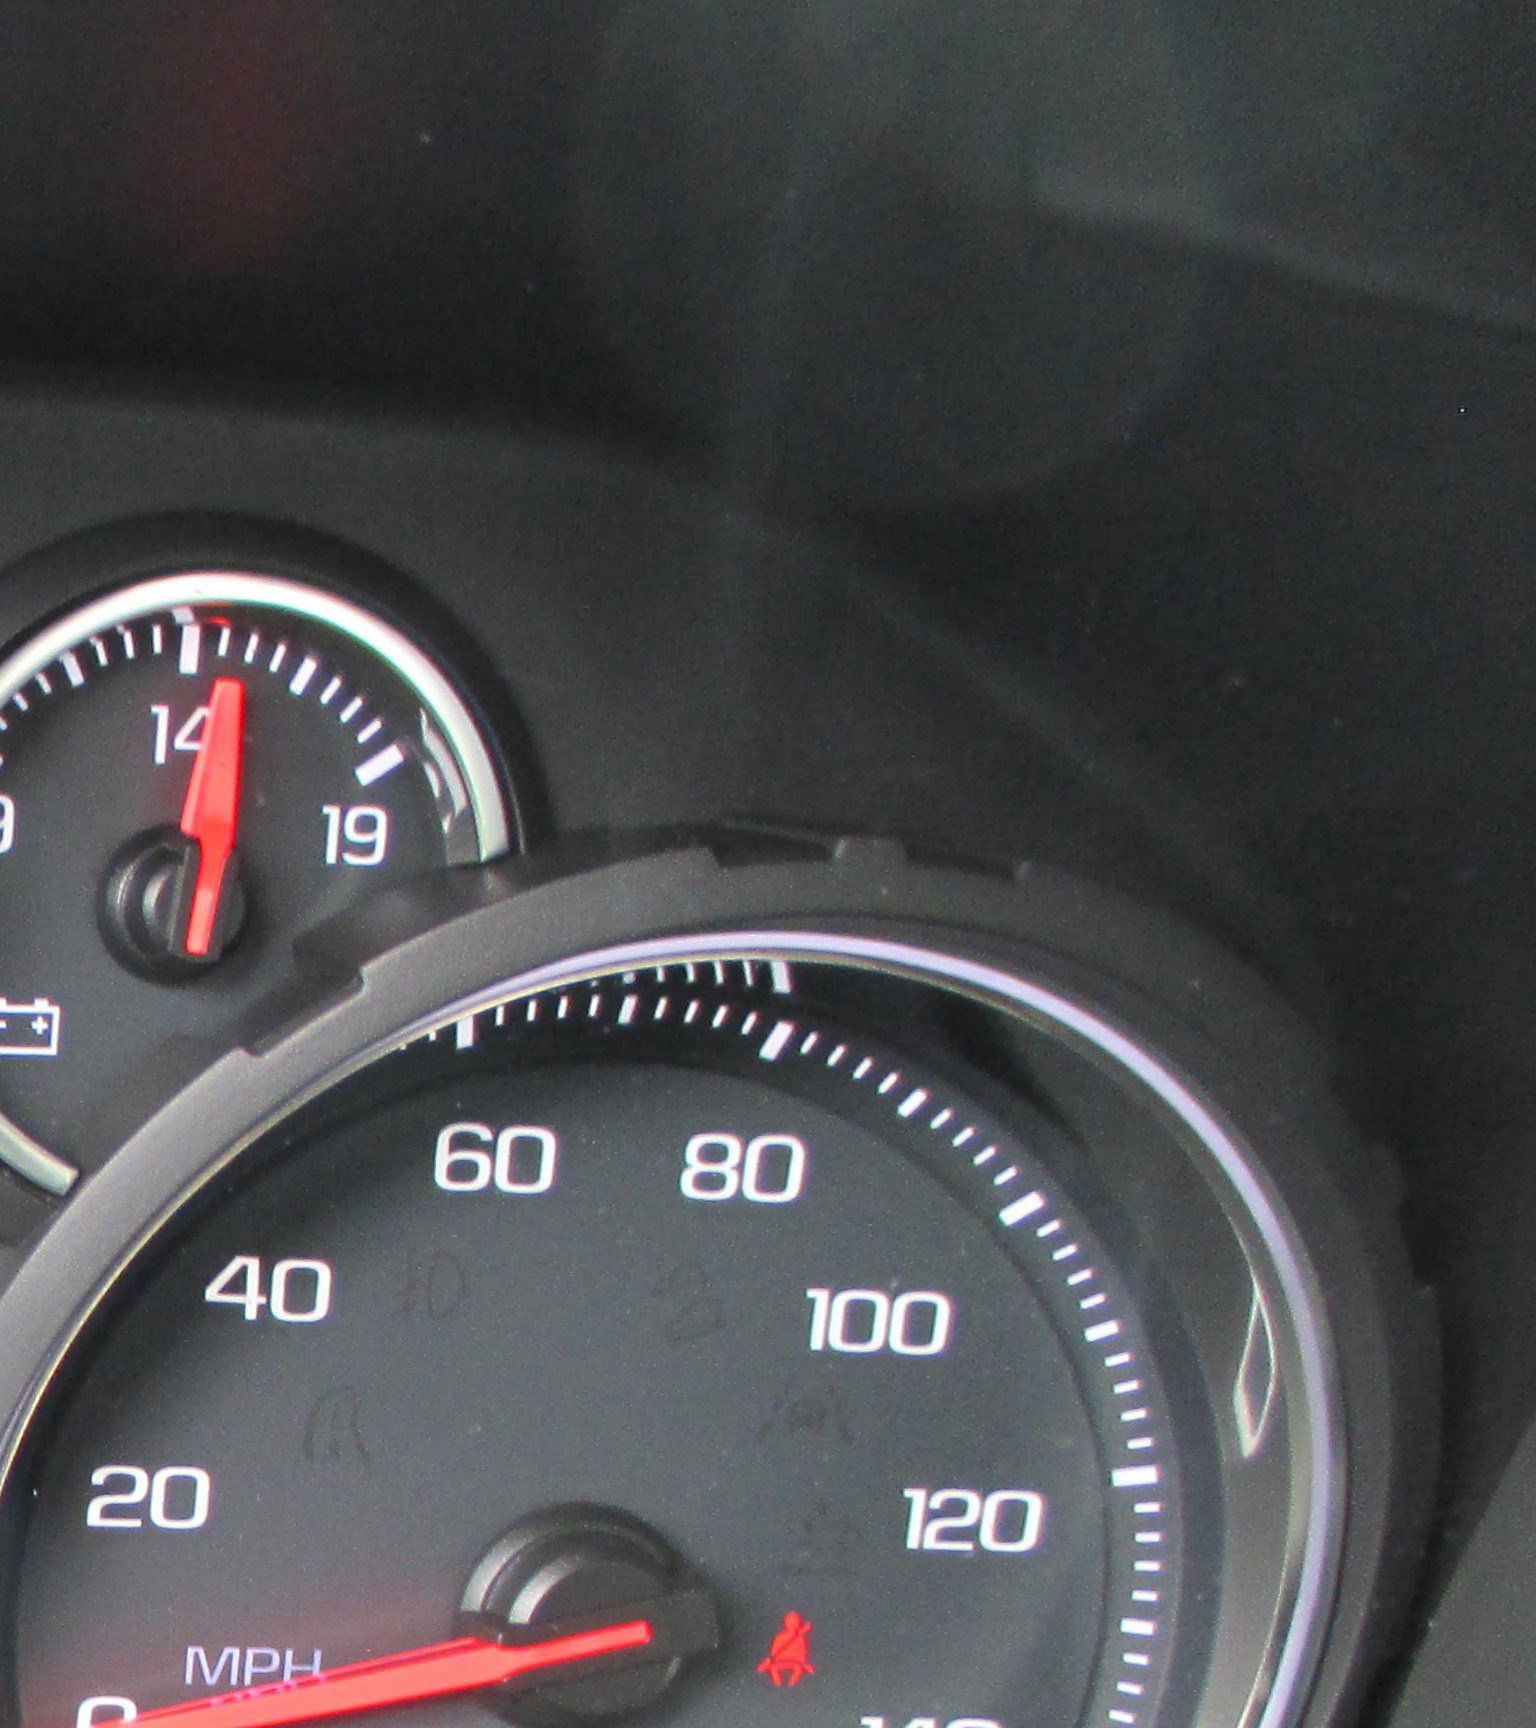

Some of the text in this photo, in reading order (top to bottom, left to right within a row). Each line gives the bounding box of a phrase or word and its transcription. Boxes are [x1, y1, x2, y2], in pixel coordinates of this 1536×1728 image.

[323, 806, 387, 866] 19
[435, 1123, 557, 1194] 60
[681, 1134, 806, 1203] 80
[205, 1256, 332, 1323] 40
[807, 1289, 951, 1355] 100
[87, 1466, 210, 1530] 20
[904, 1489, 1043, 1553] 120
[184, 1645, 324, 1688] MPH
